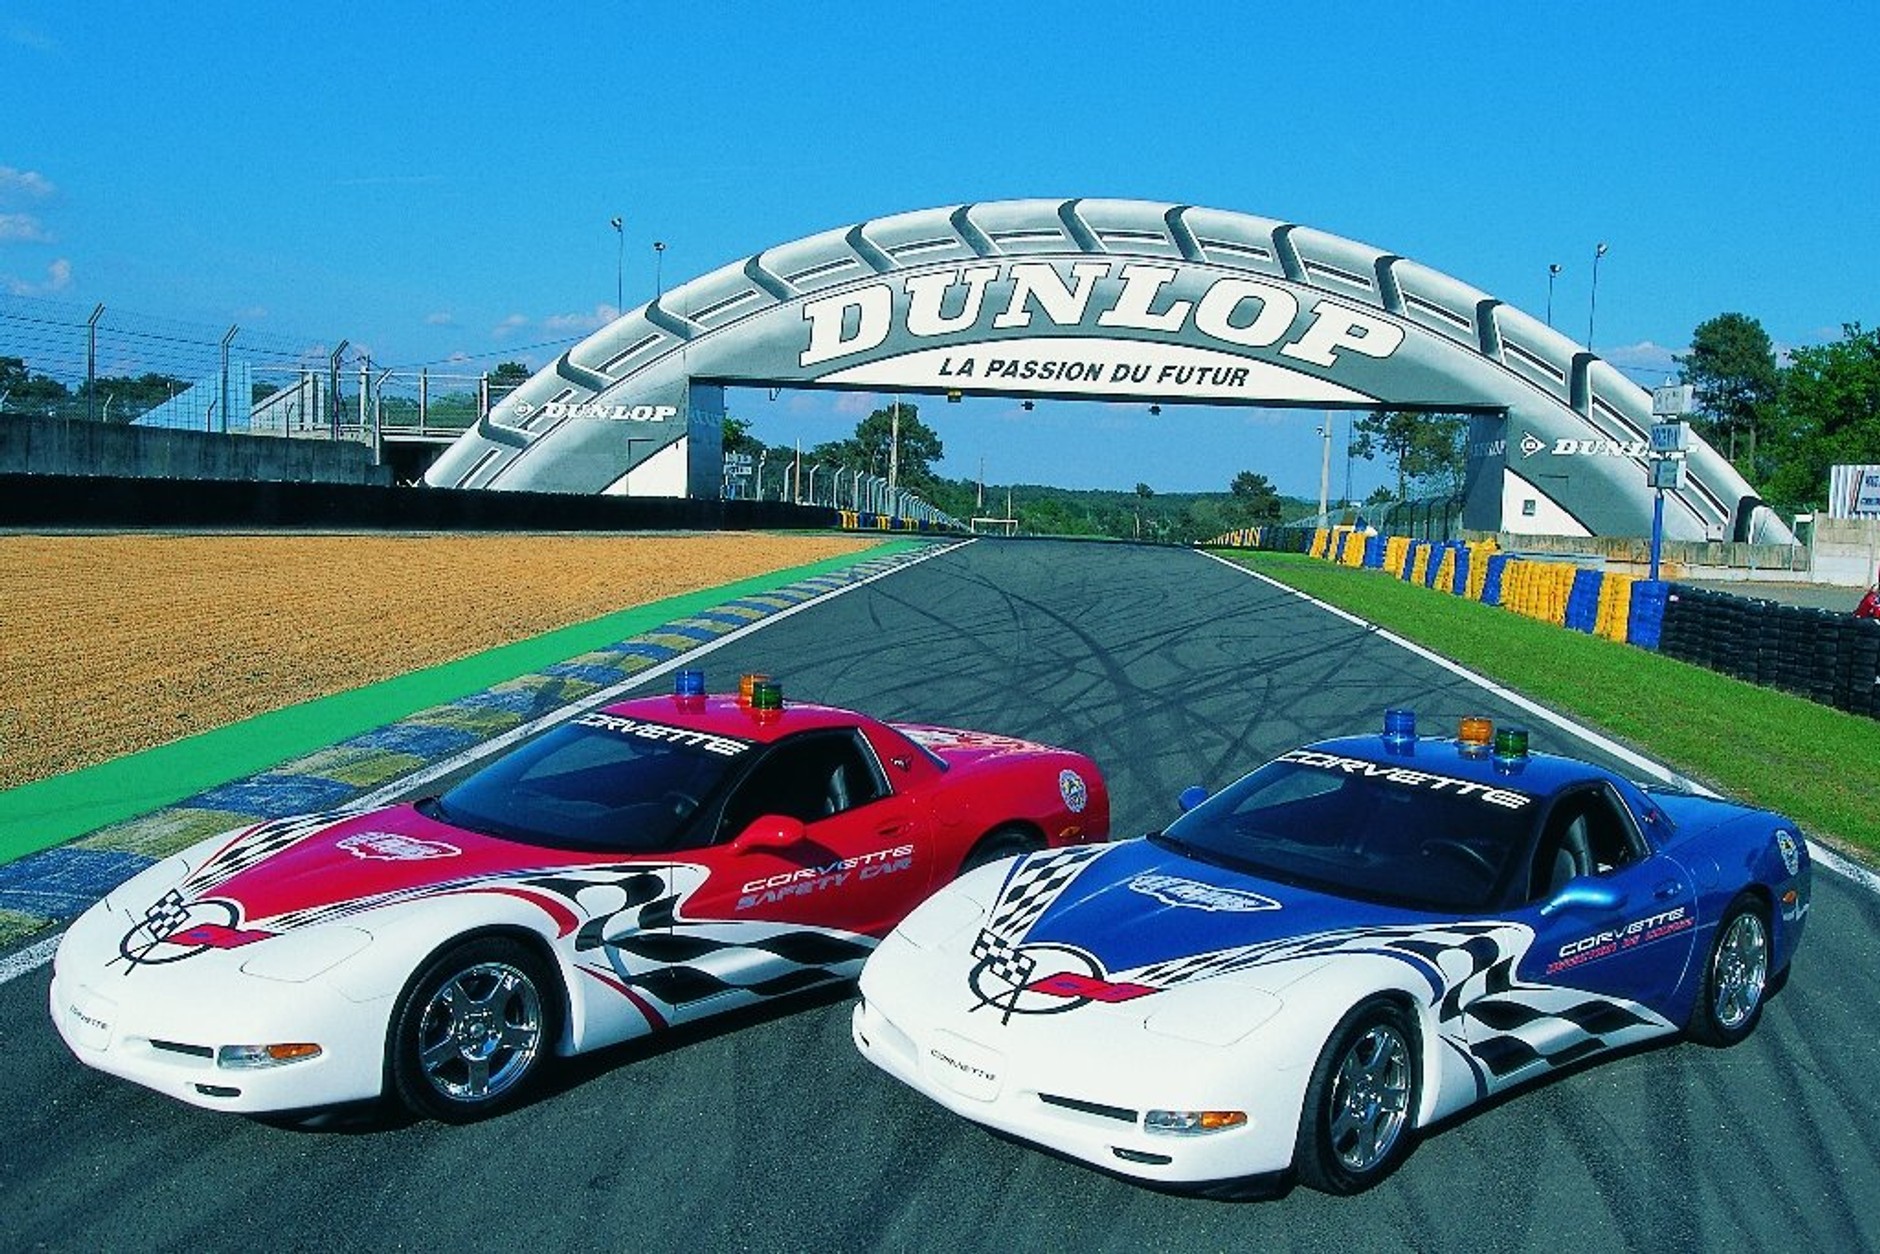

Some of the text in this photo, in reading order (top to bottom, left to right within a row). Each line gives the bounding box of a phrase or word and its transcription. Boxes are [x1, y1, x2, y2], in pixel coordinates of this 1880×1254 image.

[799, 262, 1405, 368] DUNLOP
[938, 357, 1250, 388] LA PASSION DU FUTUR
[541, 403, 677, 422] DUNLOP
[1277, 750, 1531, 809] CORVETTE
[735, 856, 912, 911] SAFETY CAR
[742, 844, 914, 893] CORVETTE
[1558, 906, 1685, 957] CORVETTE
[930, 1049, 995, 1081] CORVETTE
